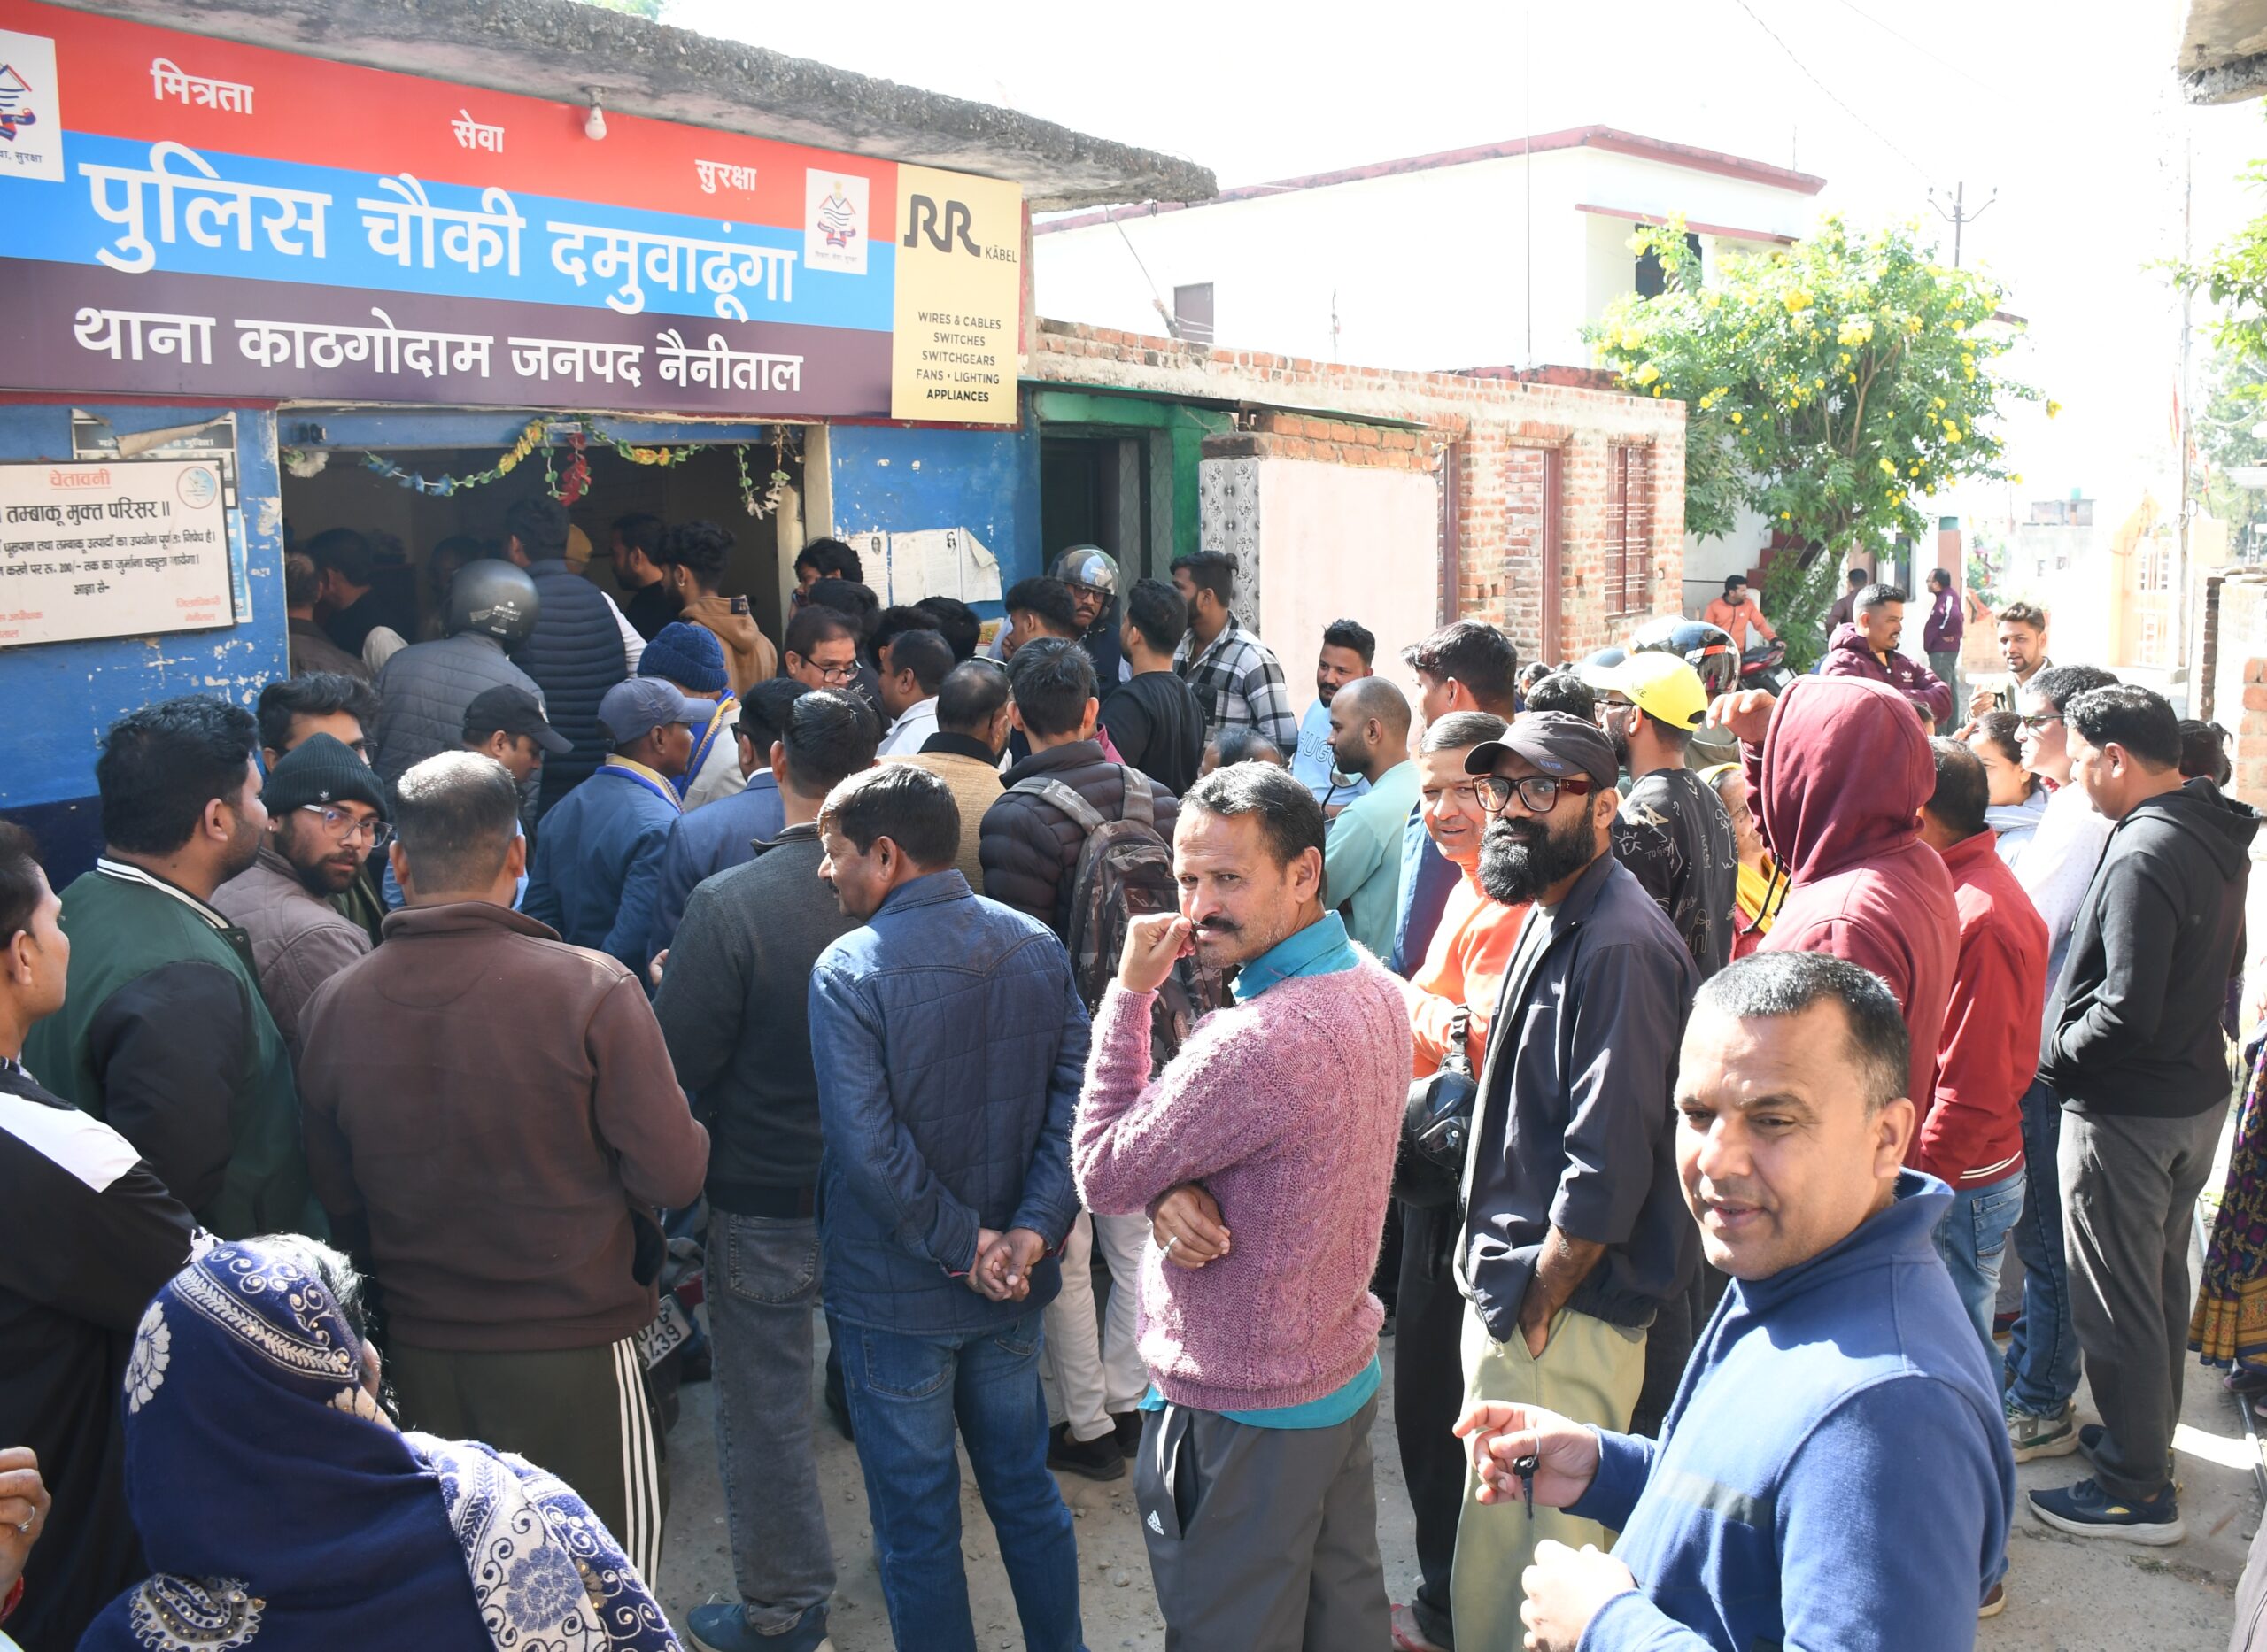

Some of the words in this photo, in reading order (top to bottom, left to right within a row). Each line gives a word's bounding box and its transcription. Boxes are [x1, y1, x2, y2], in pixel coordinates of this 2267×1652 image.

[150, 58, 254, 115] मित्रता
[452, 109, 505, 154] सेवा
[695, 159, 756, 193] सुरक्षा
[14, 151, 43, 165] सुरक्षा
[78, 141, 332, 274] पुलिस
[357, 173, 526, 276] चौकी
[547, 221, 798, 323] दमुवाढूंगा
[904, 194, 980, 258] RR
[918, 311, 951, 325] WIRES
[955, 315, 960, 326] &
[963, 316, 1002, 329] CABLES
[933, 332, 986, 346] SWITCHES
[74, 307, 216, 365] थाना
[235, 307, 494, 379] काठगोदाम
[508, 336, 644, 388] जनपद
[656, 328, 804, 393] नैनीताल
[922, 350, 995, 366] SWITCHGEARS
[917, 368, 943, 381] FANS
[954, 372, 1000, 384] LIGHTING
[926, 389, 989, 402] APPLIANCES
[50, 469, 111, 488] चेतावनी
[6, 505, 65, 526] तम्बाकू
[66, 504, 103, 525] मुक्त
[108, 496, 158, 519] परिसर
[116, 537, 128, 546] का
[30, 564, 42, 575] पर
[84, 561, 99, 572] तक
[102, 560, 113, 570] का
